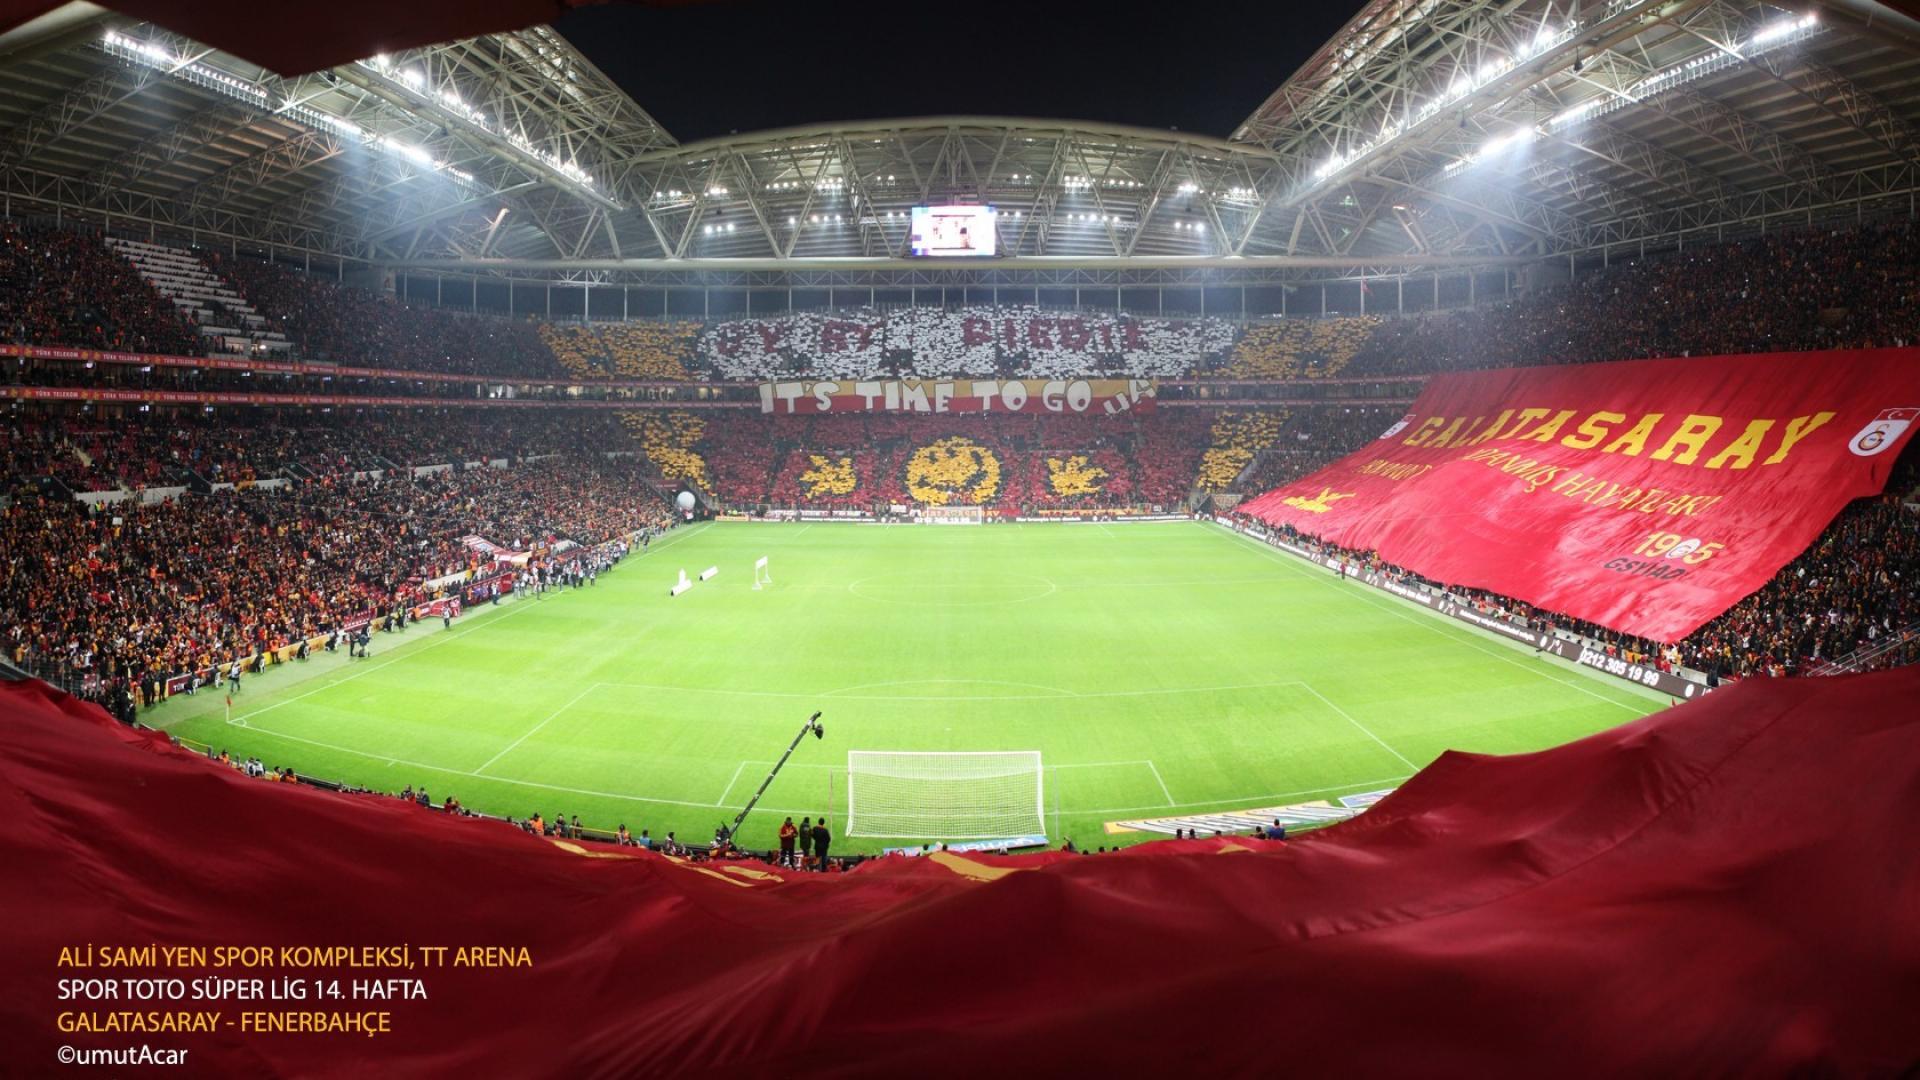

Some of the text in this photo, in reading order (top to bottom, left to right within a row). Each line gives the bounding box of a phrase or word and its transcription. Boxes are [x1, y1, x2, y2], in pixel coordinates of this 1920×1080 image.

[758, 381, 841, 414] IT'S
[854, 380, 955, 414] TIME
[971, 380, 1028, 412] TO
[1042, 380, 1094, 412] GO
[1402, 408, 1837, 470] GALATASARAY
[1605, 657, 1628, 676] 305
[1628, 665, 1643, 681] 19
[1642, 670, 1660, 687] 99
